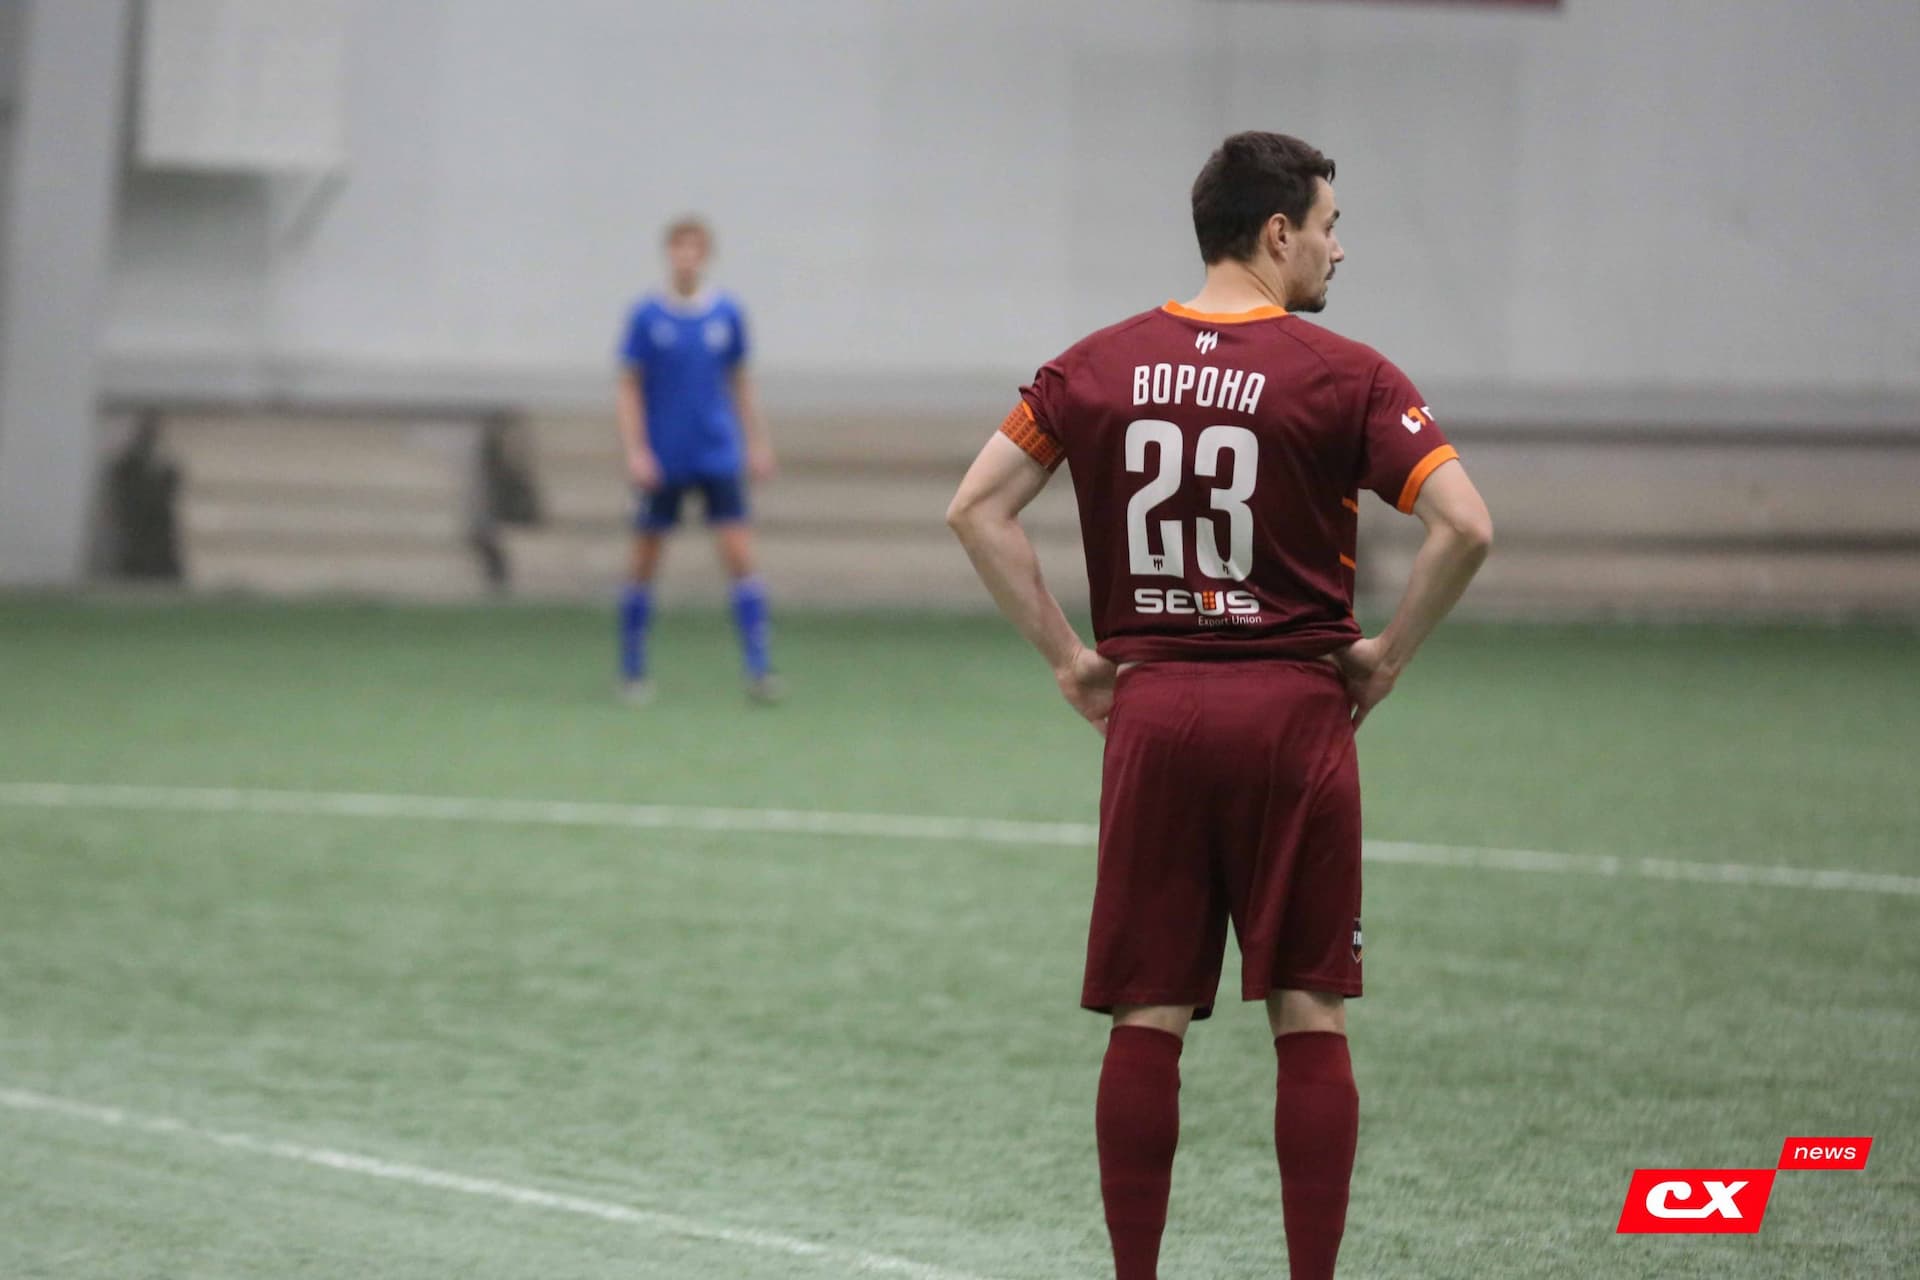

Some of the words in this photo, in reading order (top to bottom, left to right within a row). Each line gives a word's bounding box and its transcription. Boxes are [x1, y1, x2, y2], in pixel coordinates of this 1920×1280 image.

[1132, 362, 1266, 415] ВОРОНА
[1124, 418, 1259, 582] 23
[1134, 588, 1260, 616] SEUS
[1197, 615, 1229, 628] Export
[1231, 614, 1263, 625] Union
